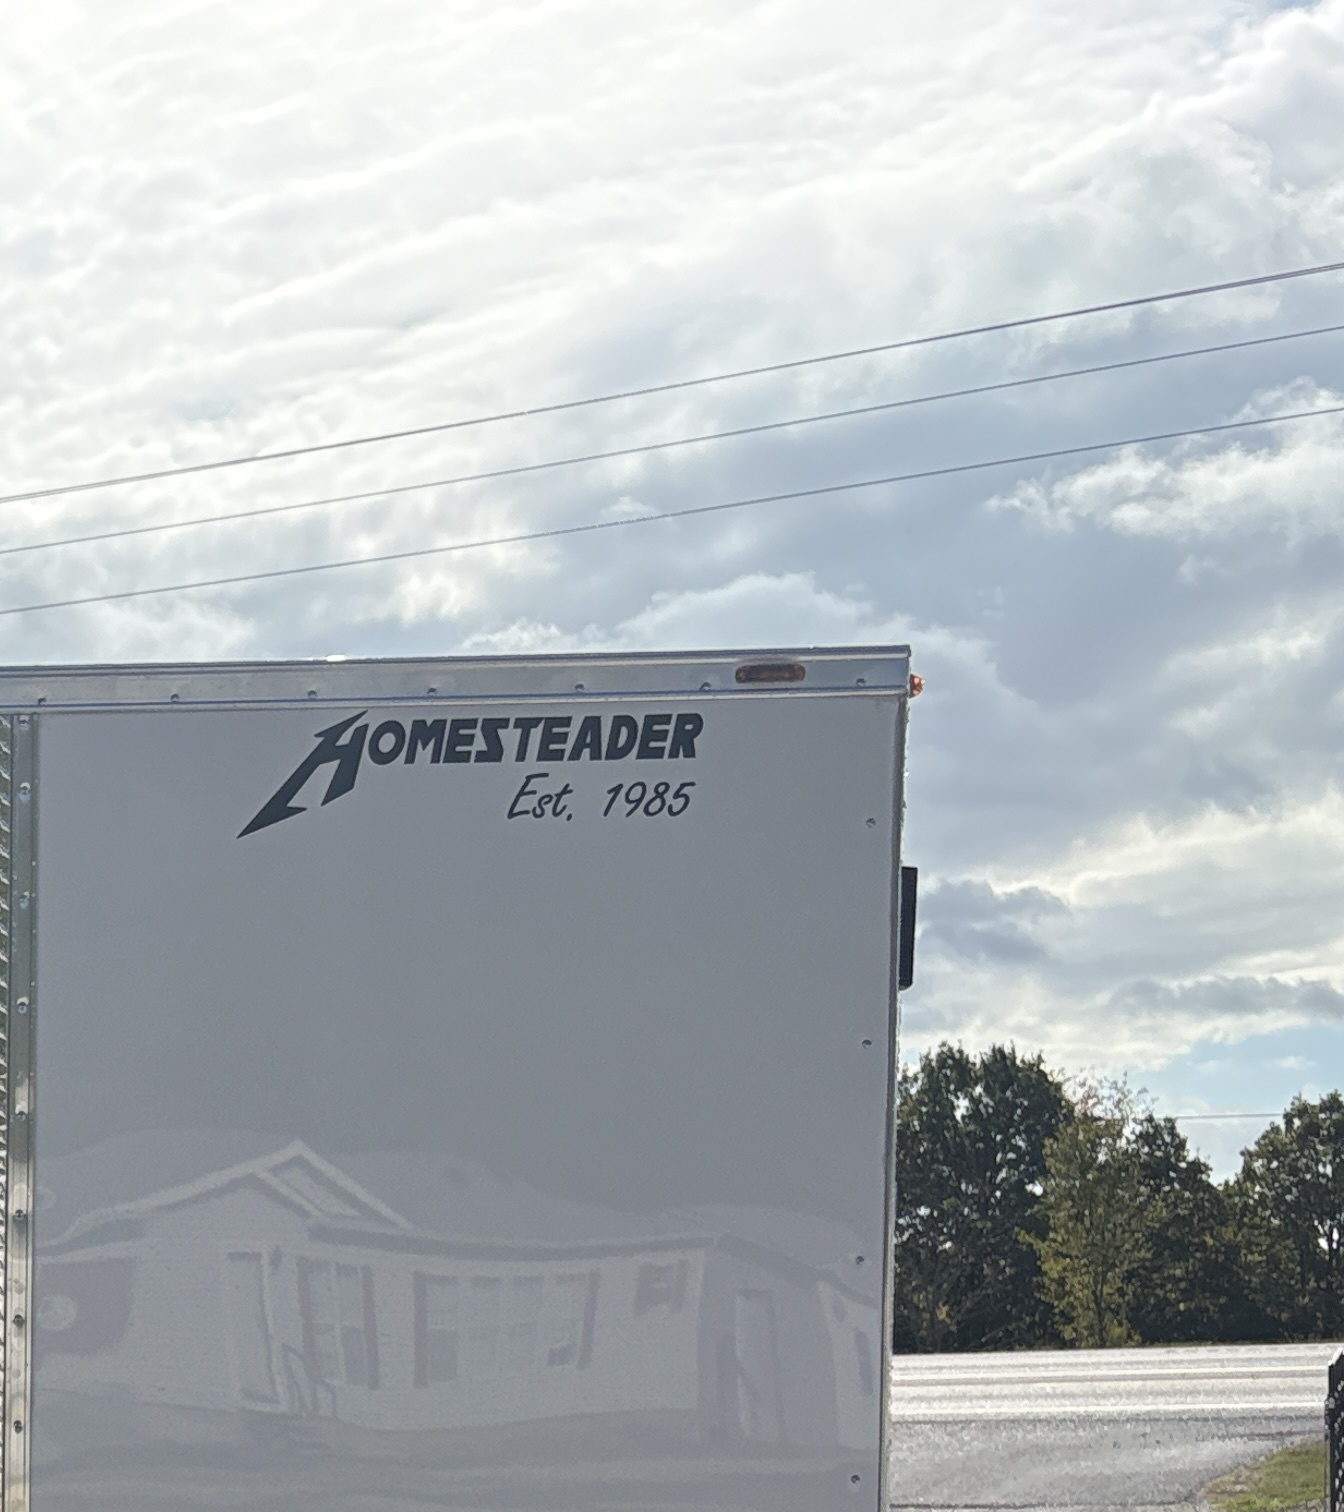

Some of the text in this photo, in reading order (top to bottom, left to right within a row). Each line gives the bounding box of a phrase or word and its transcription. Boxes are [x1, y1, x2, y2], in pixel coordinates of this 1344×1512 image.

[236, 710, 704, 839] HOMESTEADER
[507, 772, 696, 822] Est. 1985
